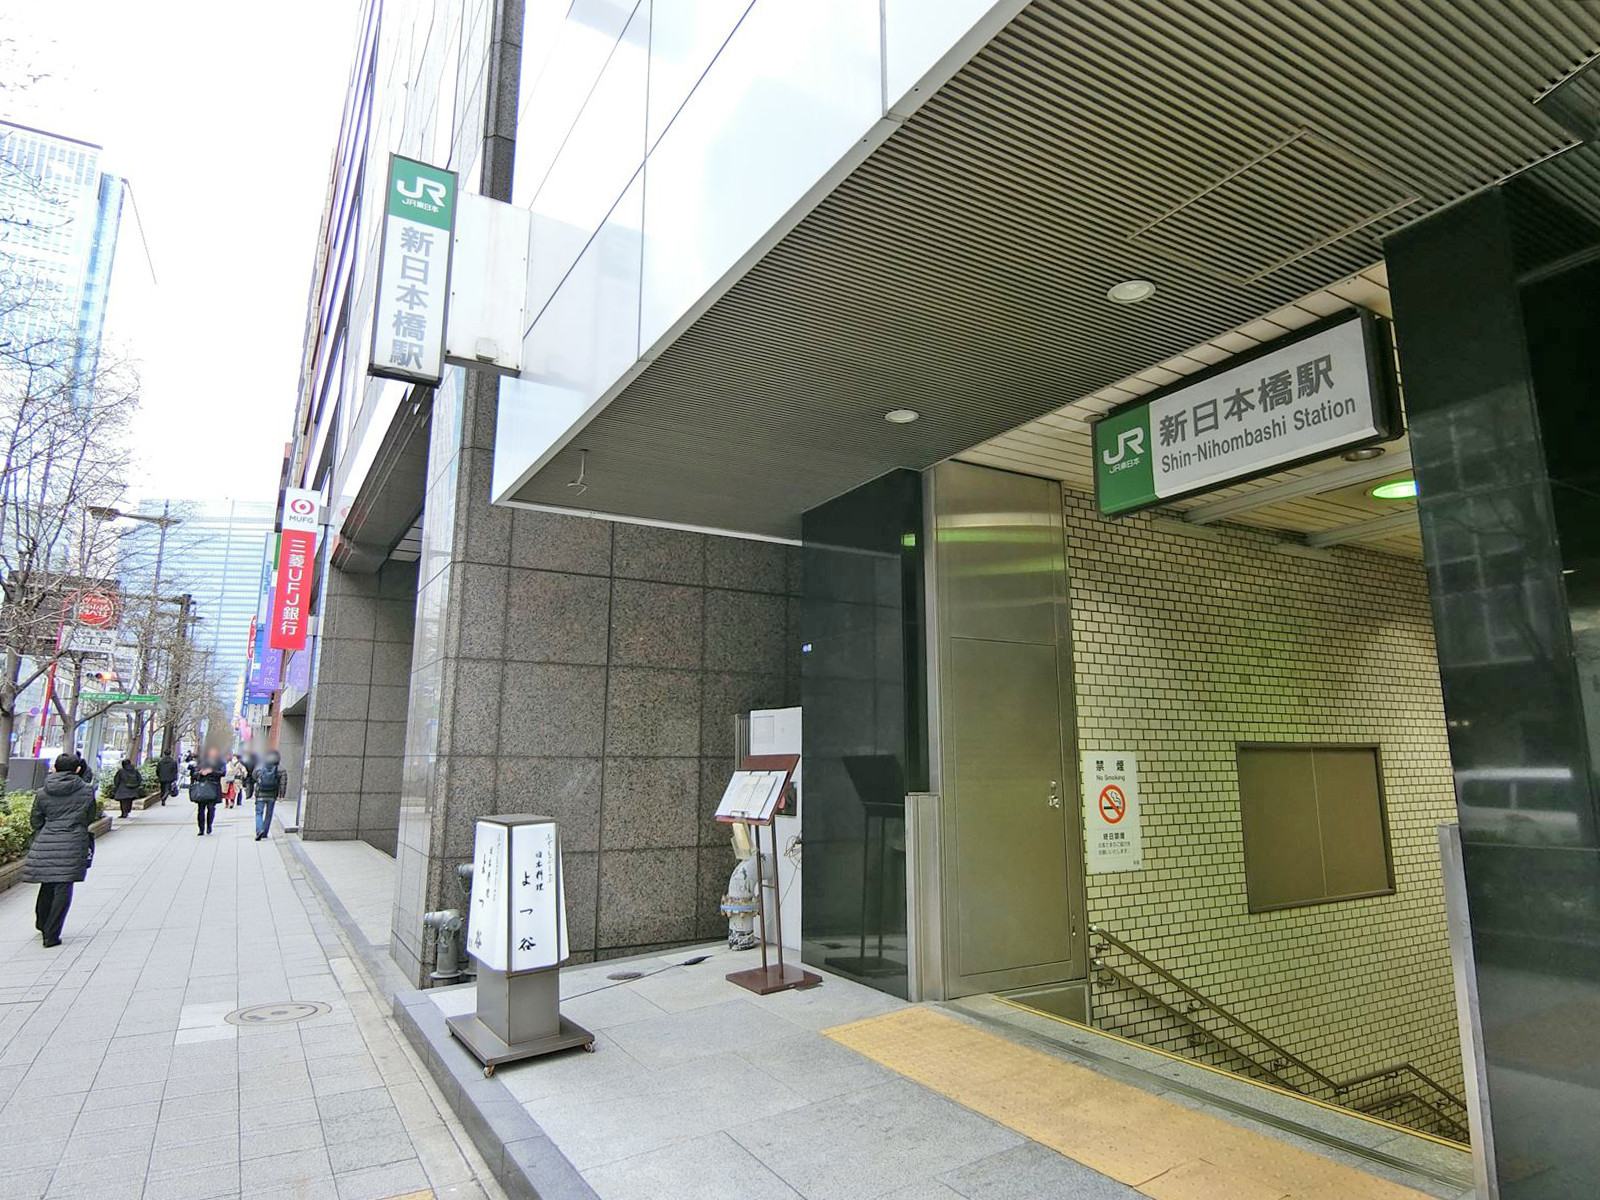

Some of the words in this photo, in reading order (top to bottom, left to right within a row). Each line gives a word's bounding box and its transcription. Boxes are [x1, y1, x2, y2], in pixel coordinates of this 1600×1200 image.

[397, 176, 447, 207] JR
[402, 198, 440, 214] JR東日本
[389, 226, 434, 371] 新日本橋駅
[1159, 354, 1334, 446] 新日本橋駅
[1102, 426, 1145, 466] JR
[1161, 415, 1287, 474] Shin-Nihombashi
[1294, 396, 1356, 431] Station
[1109, 457, 1141, 475] JR東日本
[289, 515, 314, 524] MUFG
[281, 539, 307, 636] 三菱UFJ銀行
[1095, 759, 1125, 771] 禁煙
[1104, 774, 1126, 782] Smoking
[535, 850, 544, 892] 日本料理
[518, 870, 537, 952] よつ谷
